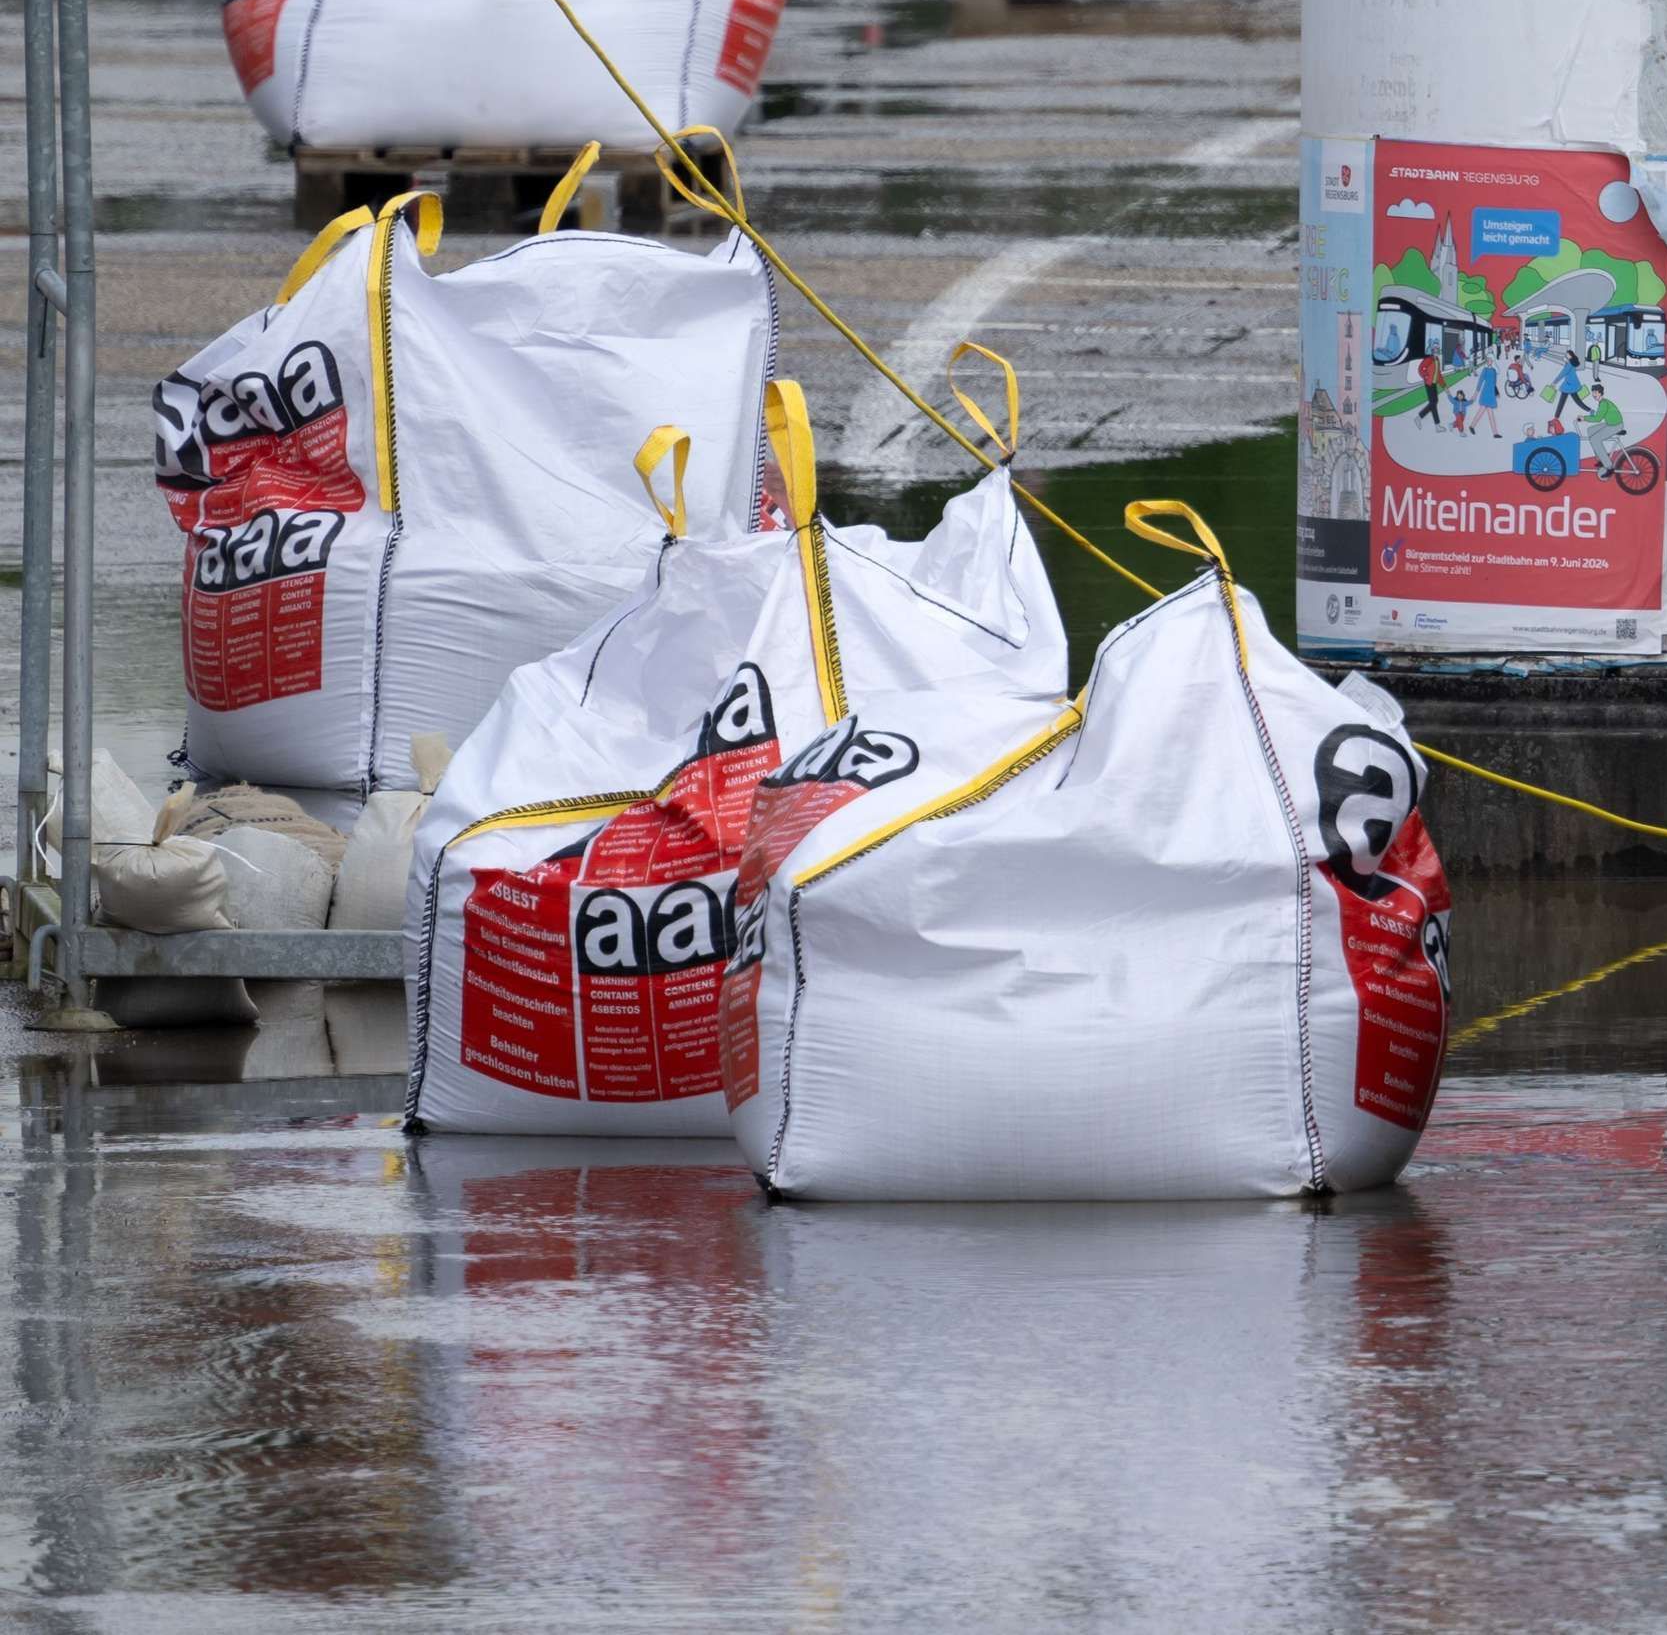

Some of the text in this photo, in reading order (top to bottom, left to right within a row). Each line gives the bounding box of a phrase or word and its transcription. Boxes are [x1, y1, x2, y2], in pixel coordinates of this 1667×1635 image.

[1325, 176, 1339, 187] STADT
[1389, 167, 1540, 187] STADTBAHN REGENSBURG
[1325, 189, 1359, 202] REGENSBURG
[1483, 219, 1533, 233] Umsteigen
[1483, 232, 1550, 246] leicht gemacht
[1381, 485, 1617, 540] Miteinander
[1405, 549, 1609, 569] Bürgerentscheid zur Stadtbahn am 9. Juni 2024
[1405, 563, 1472, 576] Ihre Stimme zählt!
[1512, 624, 1608, 636] www.stadtbahnregensburg.de
[715, 740, 774, 762] ATTENZIONE!
[721, 755, 769, 775] CONTIENE
[724, 769, 769, 788] AMIANTO
[501, 935, 546, 961] Einatmen
[466, 969, 568, 1017] Sicherheitsvorschriften
[590, 990, 640, 1000] CONTAINS
[663, 978, 717, 997] CONTIENE
[590, 1005, 641, 1015] ASBESTOS
[668, 992, 714, 1010] AMIANTO
[491, 1004, 535, 1031] beachten
[489, 1034, 540, 1064] Behälter
[464, 1046, 576, 1091] geschlossen halten
